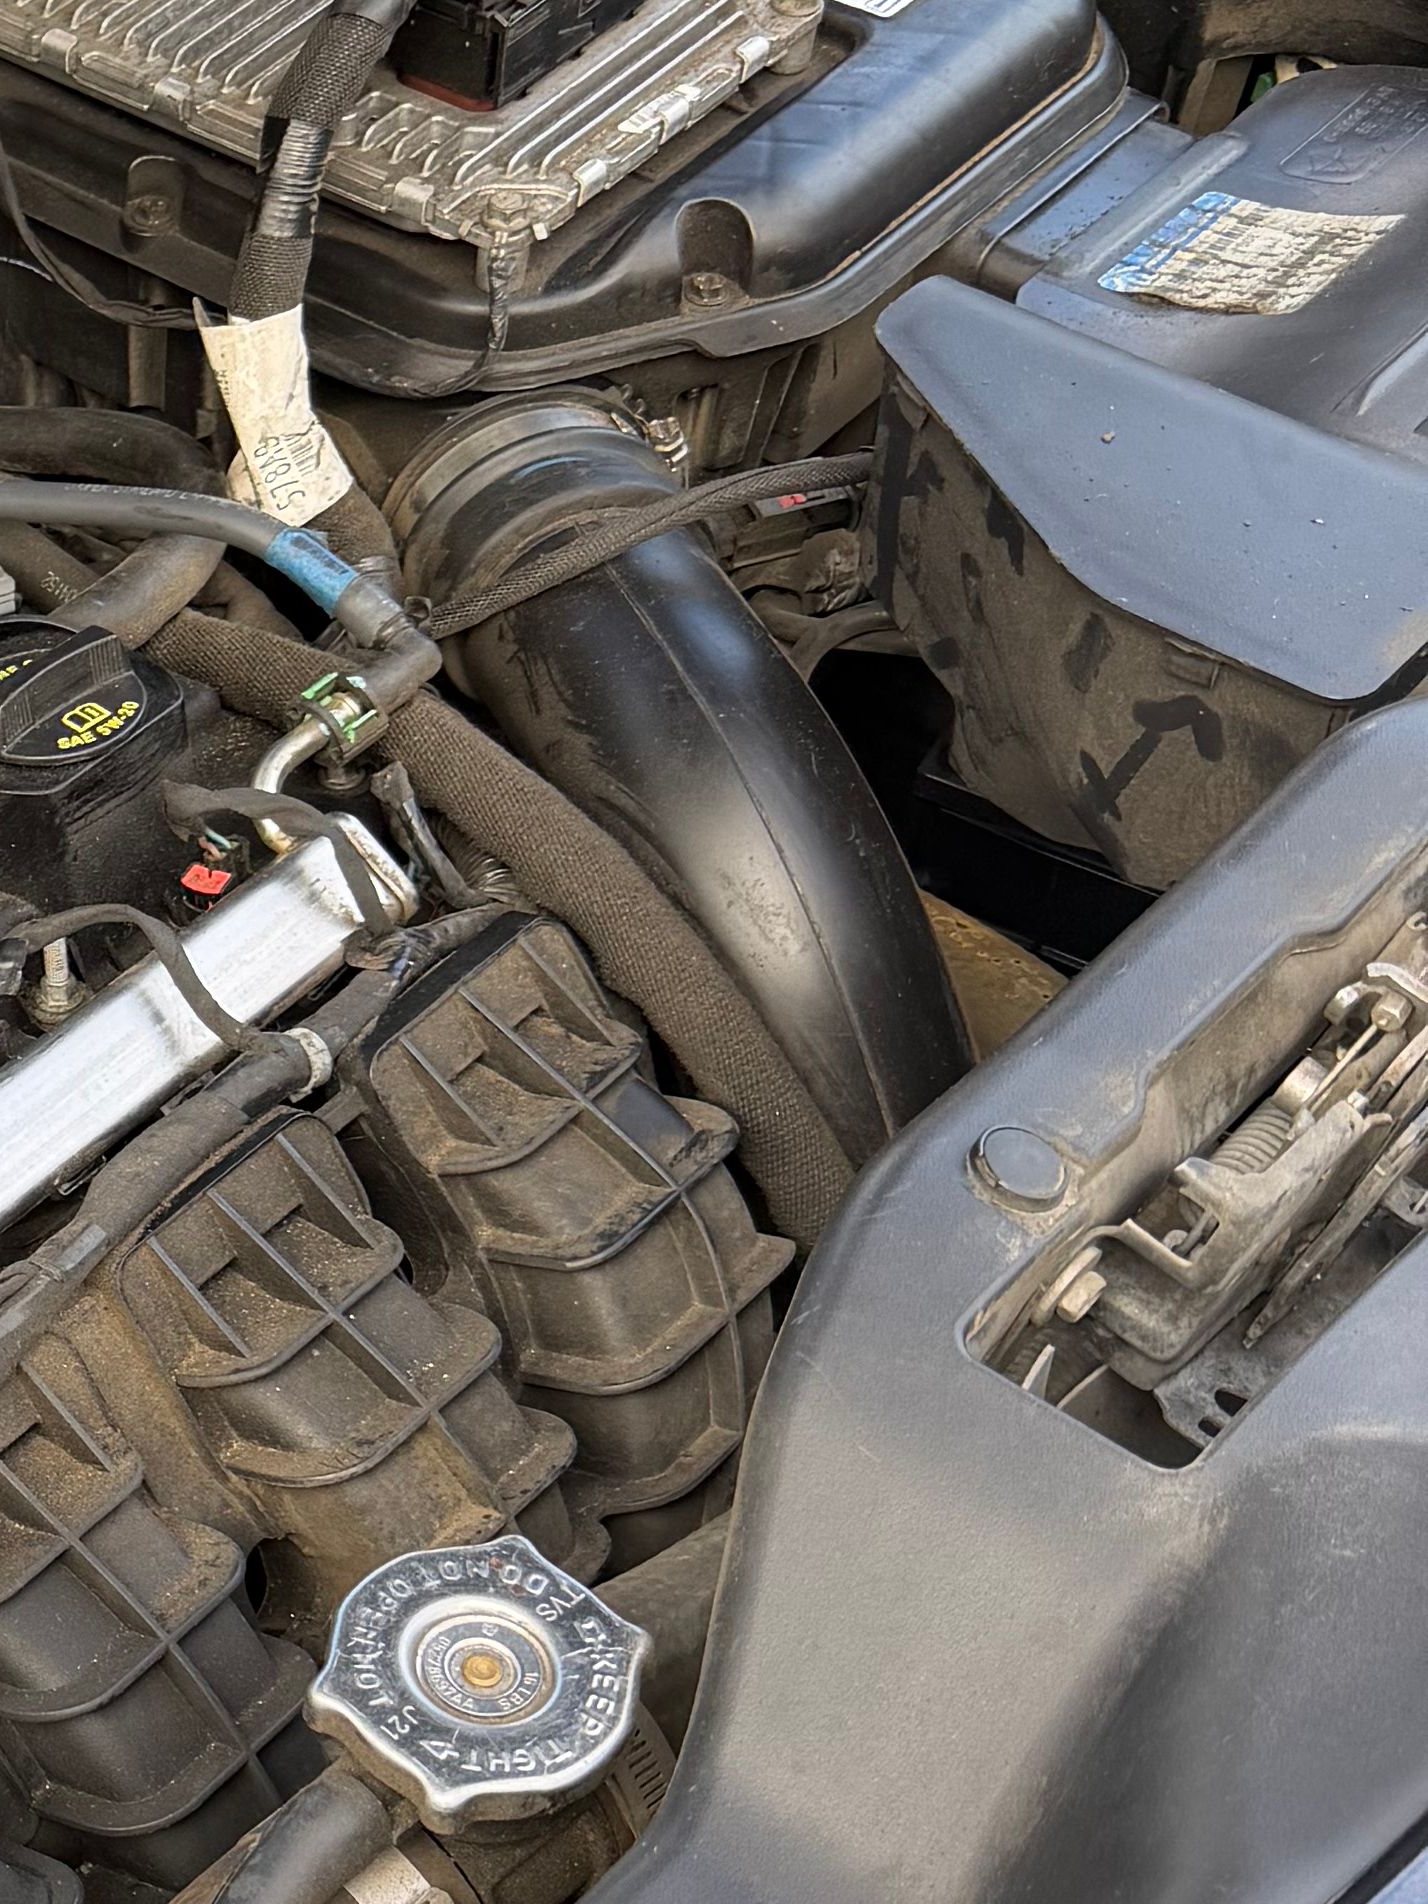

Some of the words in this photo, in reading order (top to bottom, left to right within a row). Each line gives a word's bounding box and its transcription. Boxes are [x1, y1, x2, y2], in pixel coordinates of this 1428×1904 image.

[57, 730, 97, 750] SAE
[95, 700, 140, 737] 5W-20
[410, 1557, 491, 1589] NOT
[498, 1564, 549, 1596] DO
[346, 1578, 416, 1648] OPEN
[535, 1583, 586, 1622] TVS
[350, 1650, 394, 1707] HOT
[523, 1671, 539, 1685] 16
[581, 1651, 621, 1737] KEEP
[497, 1687, 532, 1712] LBS
[380, 1704, 419, 1742] J21
[459, 1737, 574, 1774] TIGHT
